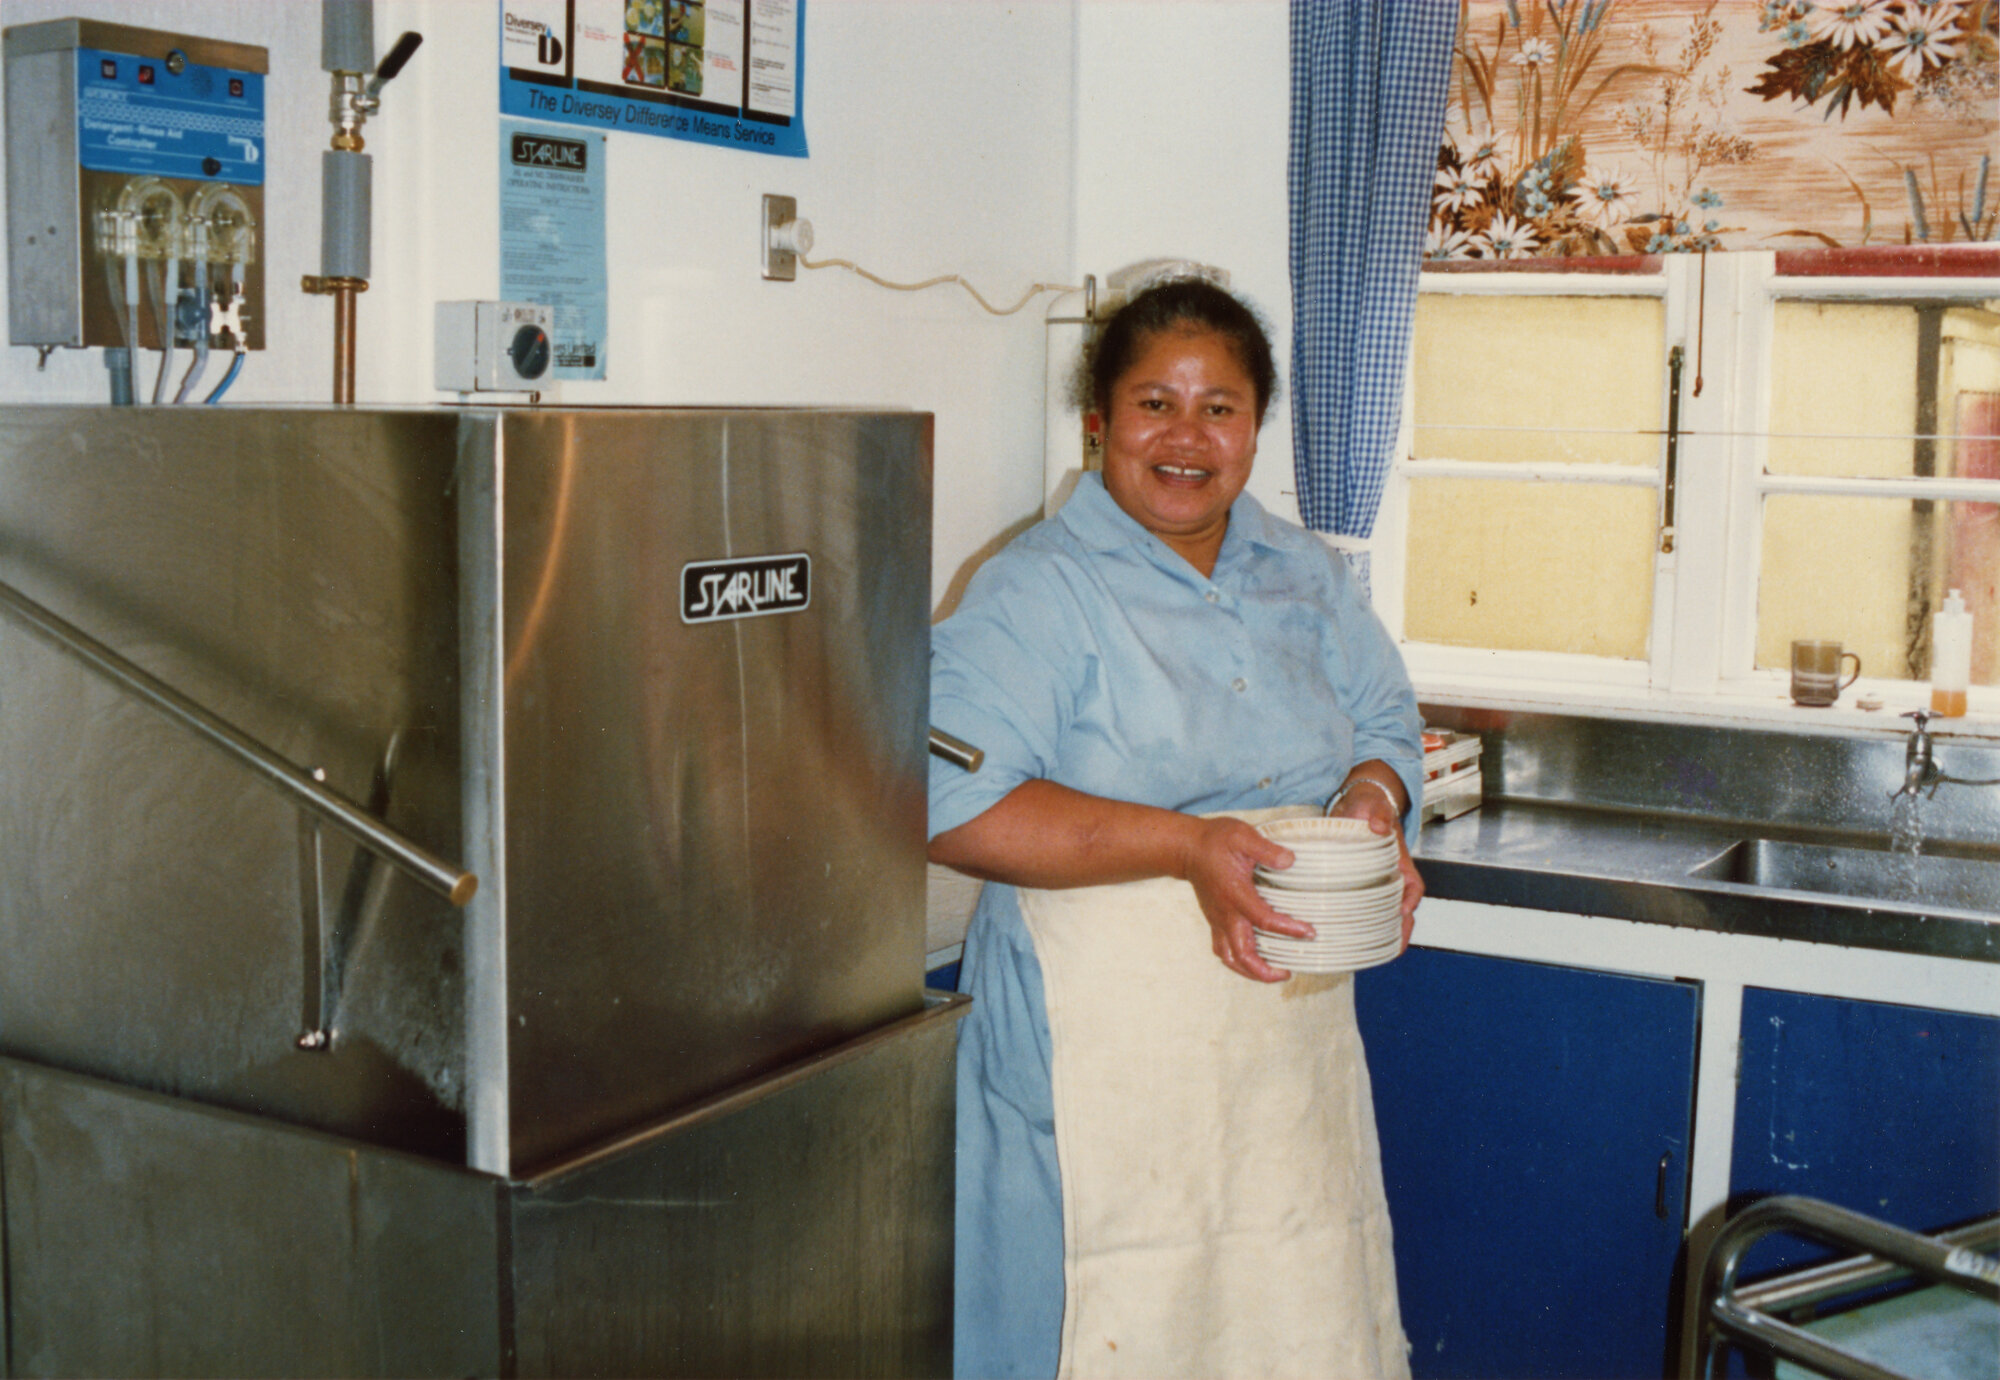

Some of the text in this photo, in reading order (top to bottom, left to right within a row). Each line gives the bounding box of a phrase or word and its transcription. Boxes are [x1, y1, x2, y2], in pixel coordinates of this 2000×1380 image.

[505, 12, 547, 34] Diversey
[529, 88, 776, 146] The Diversey Difference Means Service
[84, 118, 134, 133] Detergent
[167, 128, 183, 140] Aid
[107, 134, 158, 150] Controller
[517, 141, 583, 166] STARLINE
[689, 561, 804, 617] STARLINE
